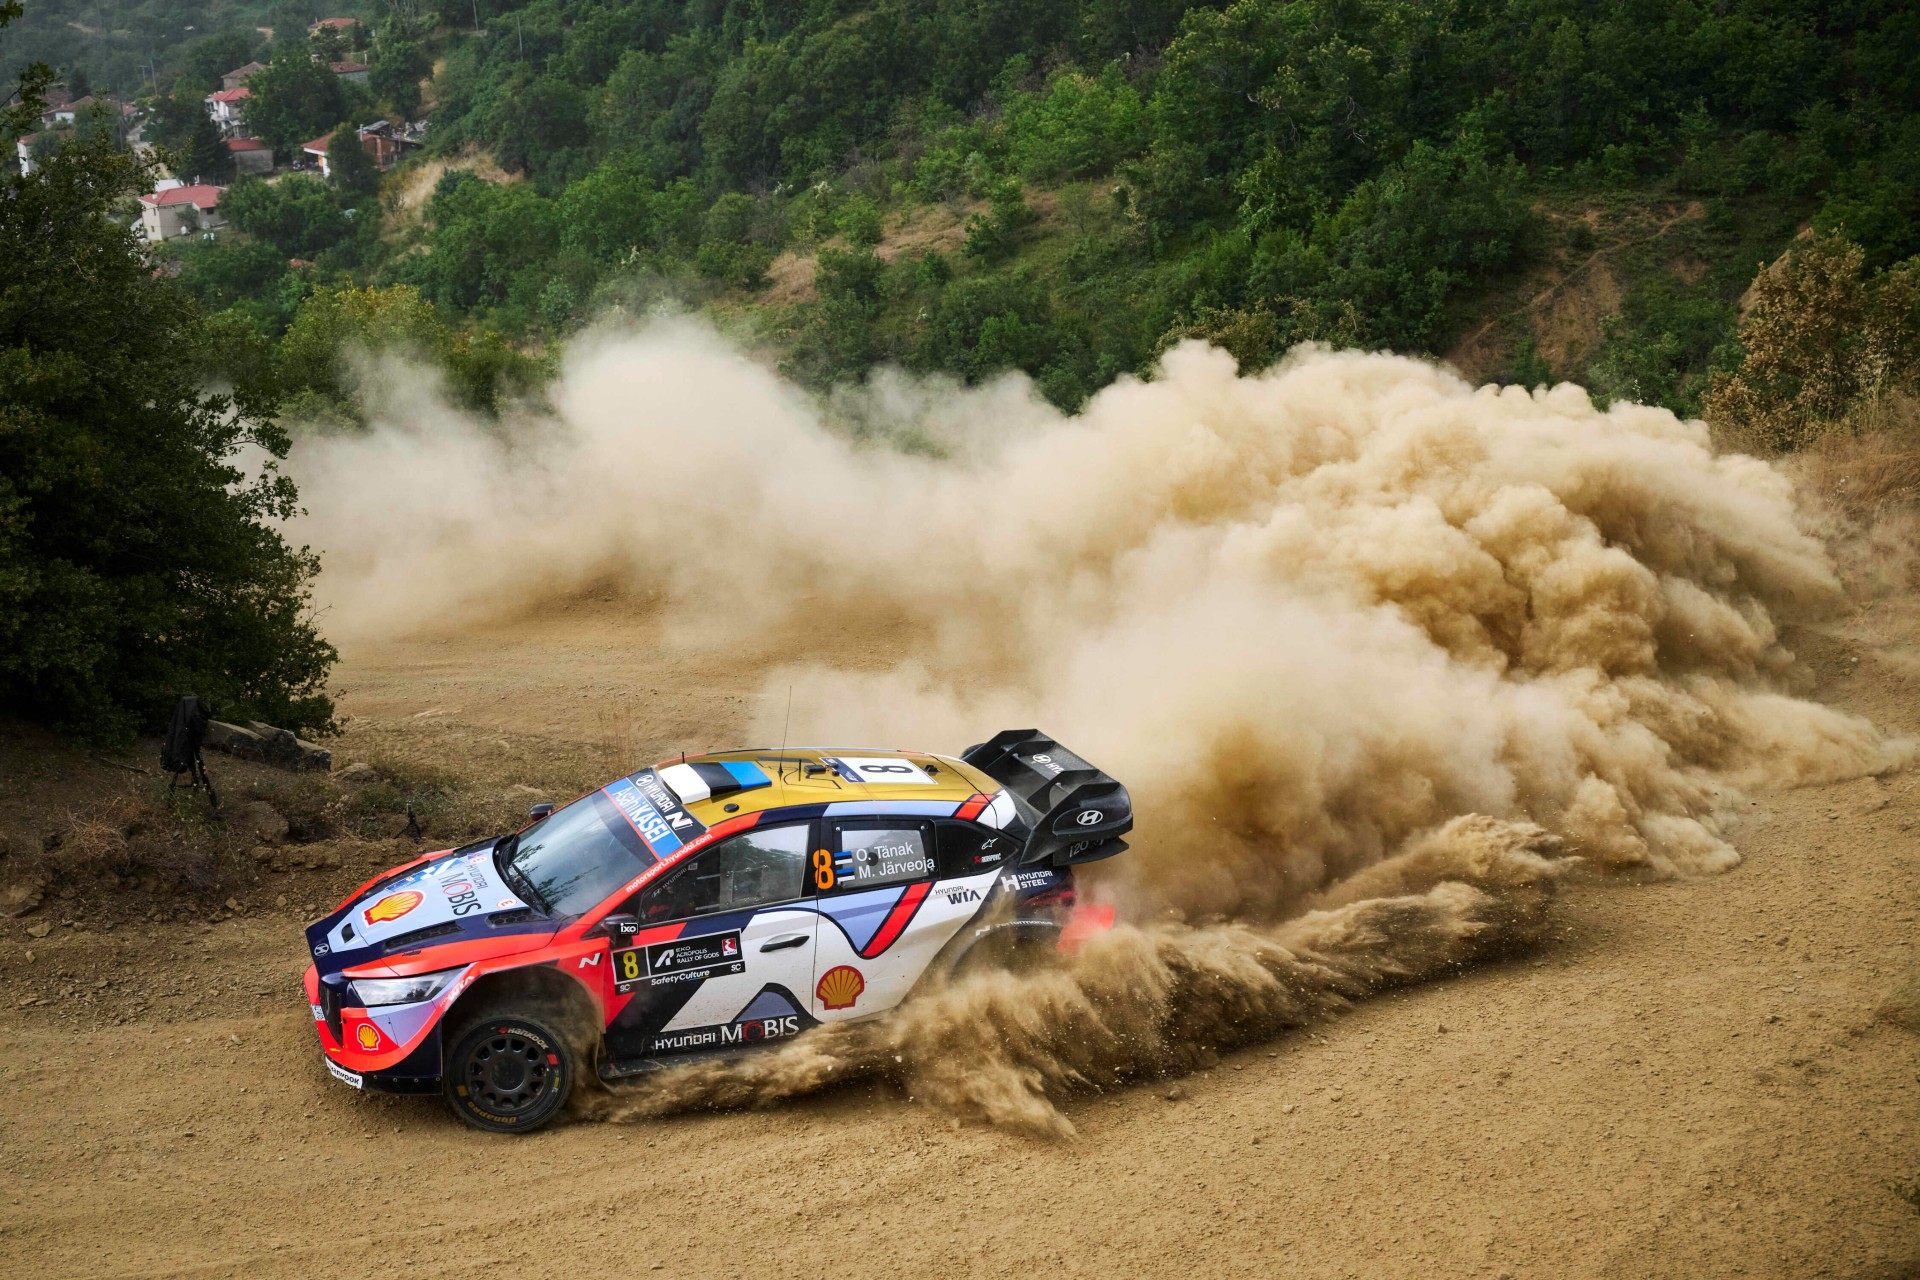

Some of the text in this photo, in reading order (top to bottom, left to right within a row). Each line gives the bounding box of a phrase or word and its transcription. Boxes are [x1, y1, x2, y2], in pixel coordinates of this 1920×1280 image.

[860, 765, 913, 774] 8
[612, 786, 671, 844] AsahiKASEI
[644, 783, 693, 831] HYUNDAI N
[856, 842, 914, 862] O. Tänak
[625, 833, 713, 893] motorsport.hyundai.com
[813, 849, 834, 890] 8
[858, 857, 935, 880] M. Järveoja
[662, 867, 688, 889] HYUNDAI
[1018, 870, 1053, 881] HYUNDAI
[1021, 878, 1048, 889] STEEL
[439, 872, 482, 916] MOBIS
[935, 886, 964, 895] HYUNDAI
[947, 889, 981, 905] WIA
[620, 923, 637, 933] ixo
[676, 948, 708, 958] ACROPOLIS
[677, 956, 694, 964] RALLY
[703, 951, 720, 960] GODS
[623, 951, 639, 979] 8
[731, 963, 742, 972] SC
[651, 969, 710, 986] SafetyCulture
[620, 984, 631, 992] SC
[655, 1016, 800, 1050] HYUNDAI MOBIS
